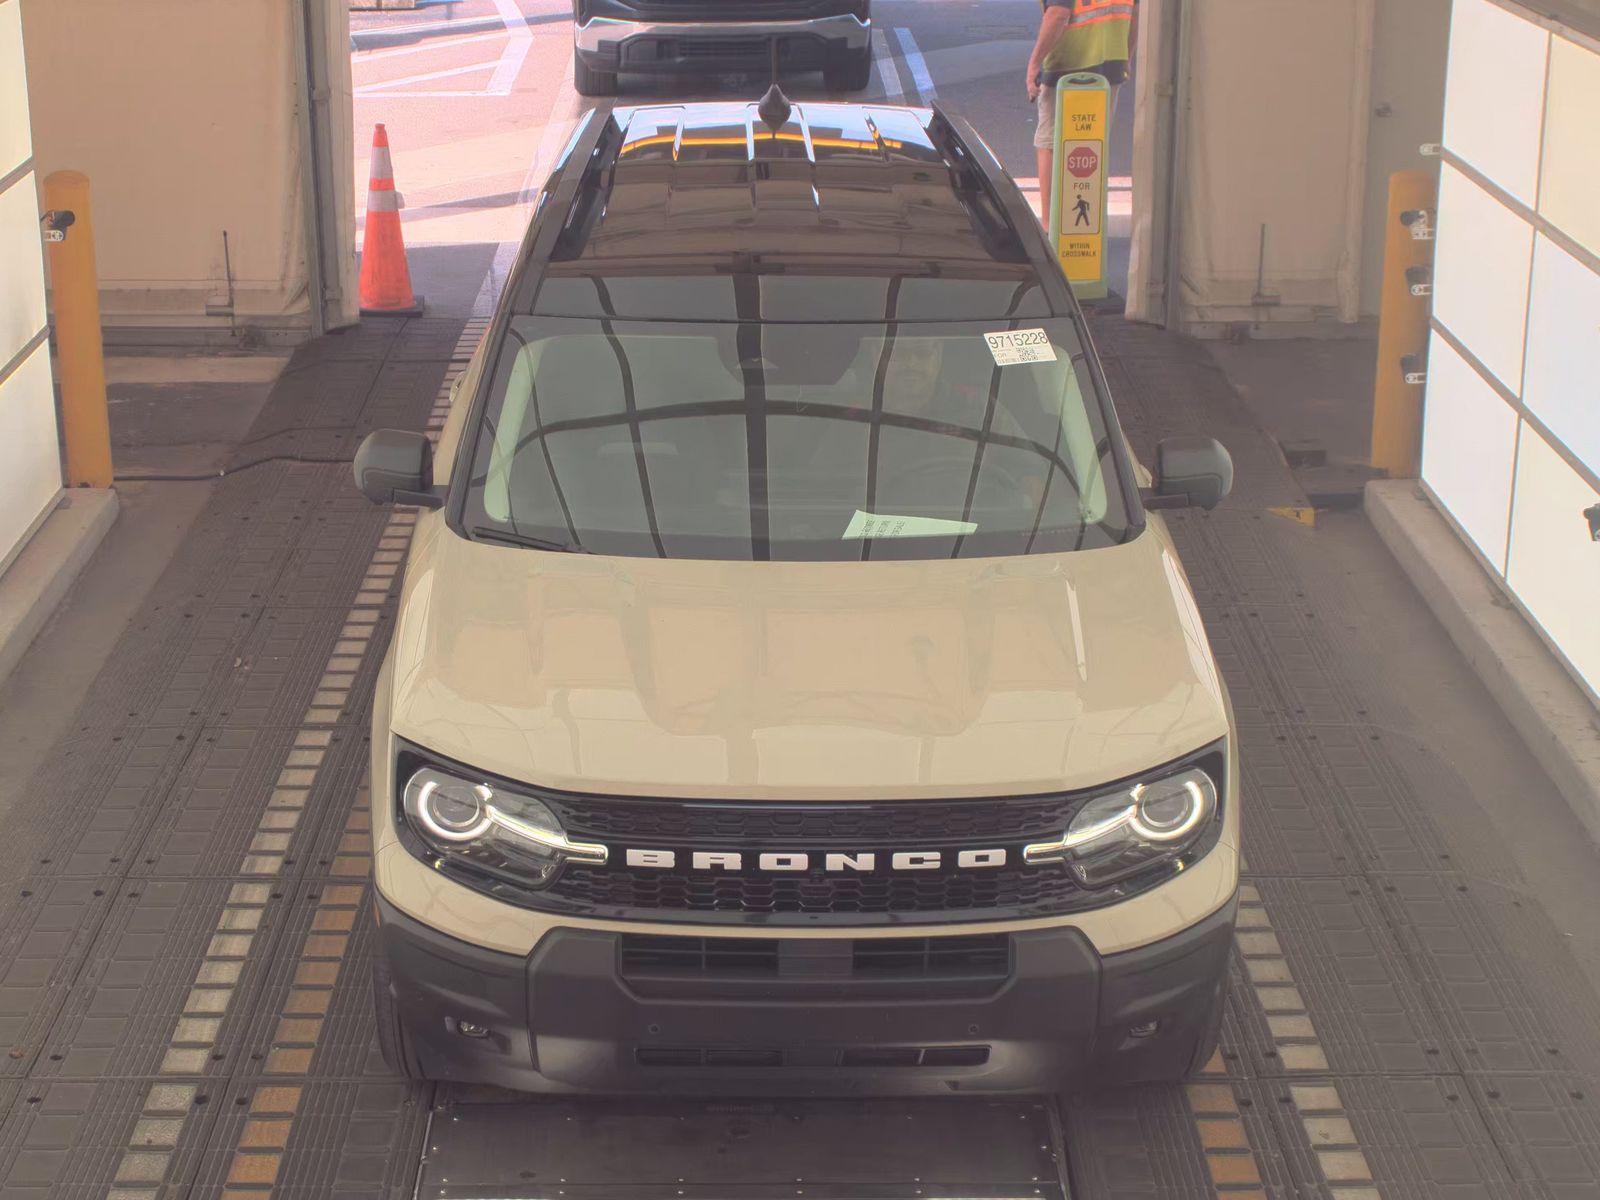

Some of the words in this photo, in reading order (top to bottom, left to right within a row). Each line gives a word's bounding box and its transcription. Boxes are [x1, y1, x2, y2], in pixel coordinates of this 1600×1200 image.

[1071, 114, 1096, 122] STATE
[1068, 156, 1097, 168] STOP
[988, 332, 1048, 349] 9715228
[626, 848, 1007, 871] BRONCO
